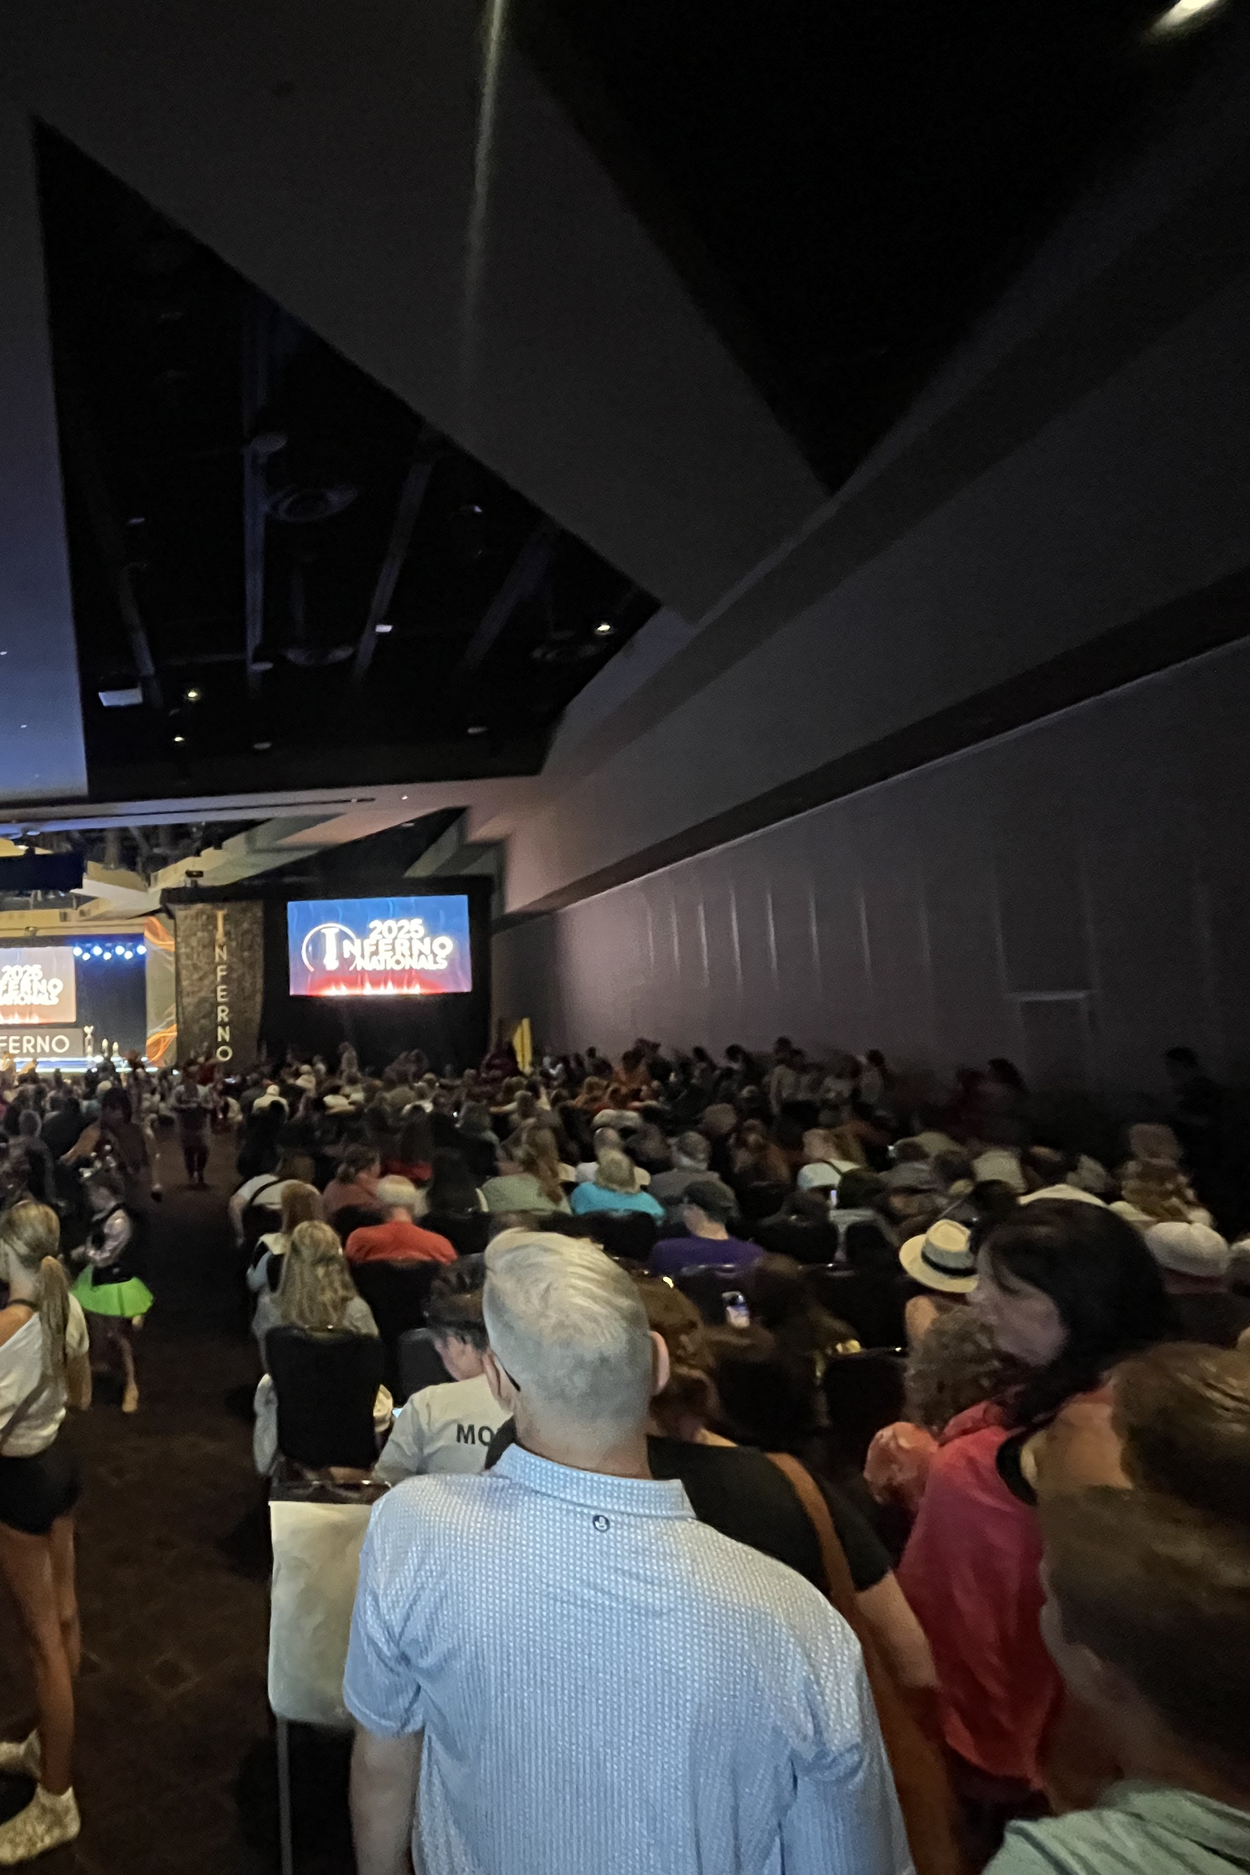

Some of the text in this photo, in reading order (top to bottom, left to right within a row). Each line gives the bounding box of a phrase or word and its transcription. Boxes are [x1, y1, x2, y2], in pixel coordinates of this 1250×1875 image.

[369, 918, 424, 939] 2025
[321, 927, 454, 970] INFERNO
[1, 964, 43, 980] 2025
[356, 954, 448, 970] NATIONALS
[214, 910, 233, 1062] INFERNO
[456, 1423, 496, 1446] MO
